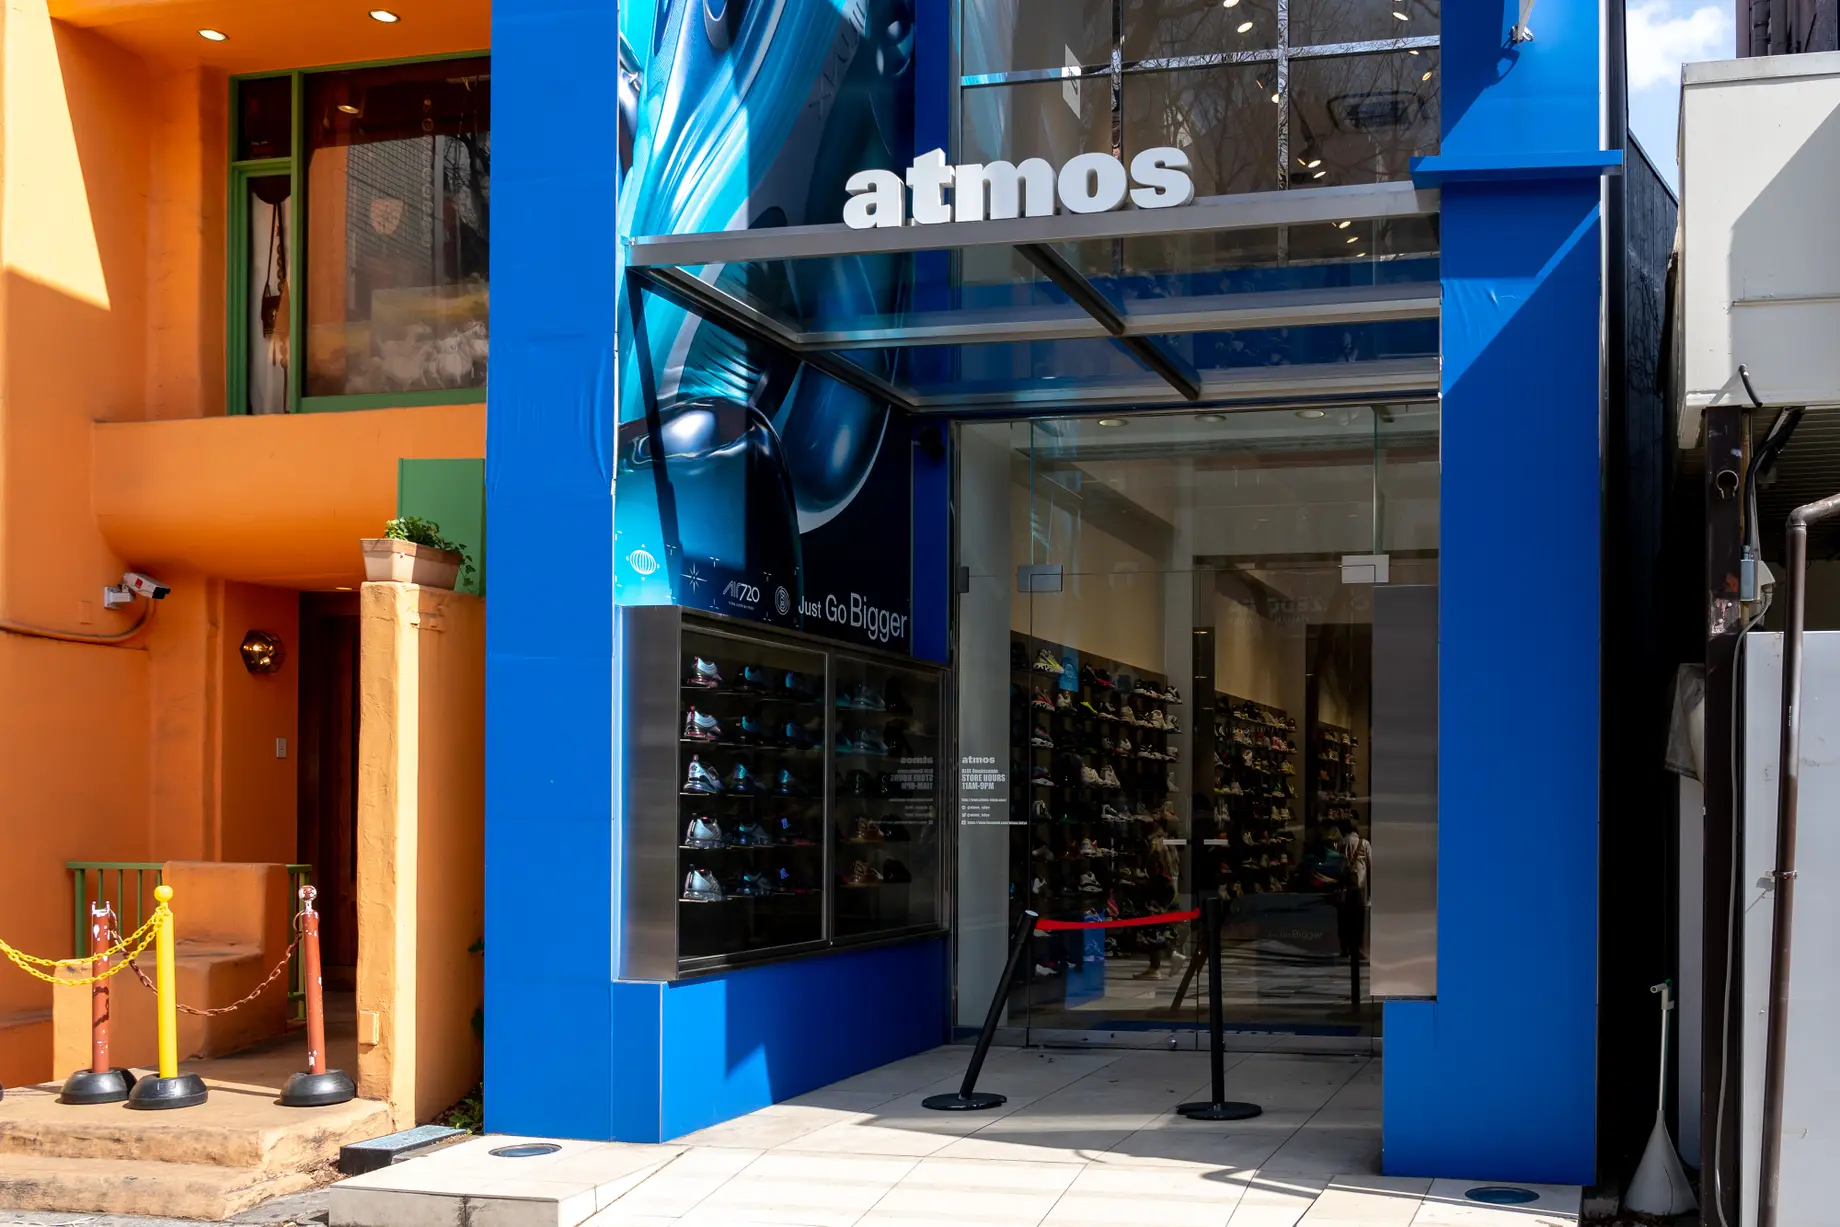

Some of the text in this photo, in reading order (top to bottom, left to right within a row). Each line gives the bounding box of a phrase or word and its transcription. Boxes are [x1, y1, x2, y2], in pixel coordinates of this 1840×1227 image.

[843, 147, 1194, 230] atmos
[798, 592, 907, 643] Just Go Bigger
[961, 755, 996, 764] atmos
[961, 774, 1006, 782] STORE HOURS
[961, 782, 995, 790] 11AM-9PM
